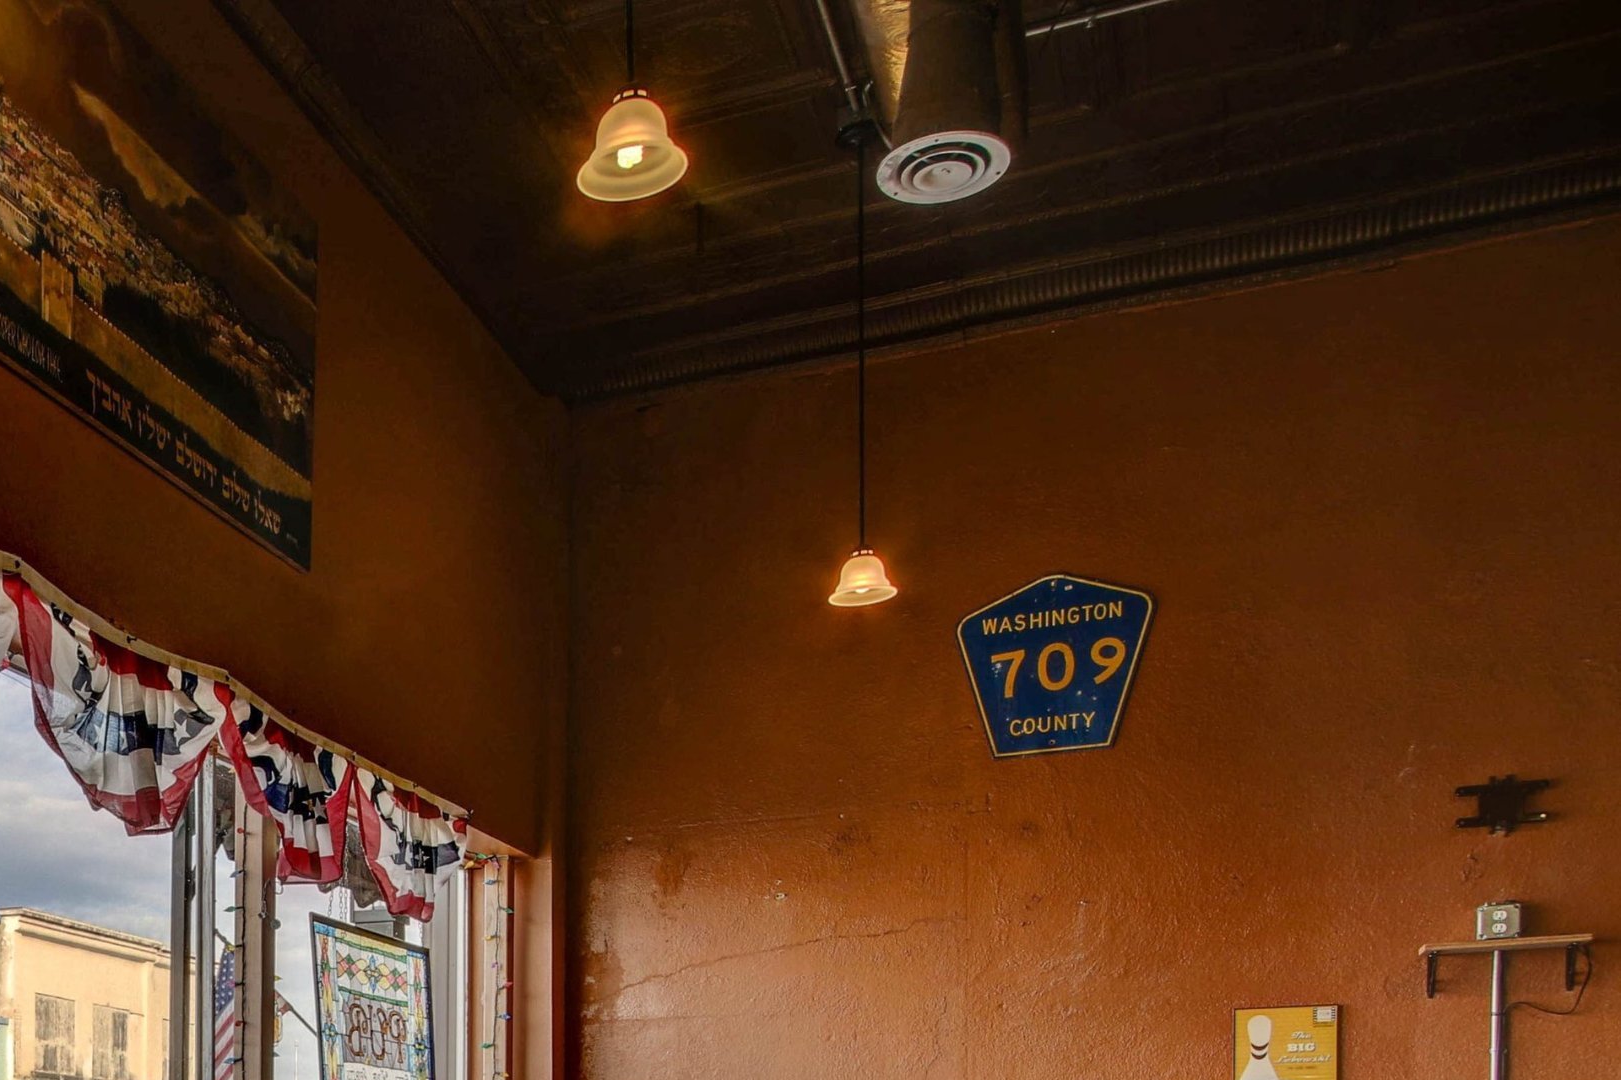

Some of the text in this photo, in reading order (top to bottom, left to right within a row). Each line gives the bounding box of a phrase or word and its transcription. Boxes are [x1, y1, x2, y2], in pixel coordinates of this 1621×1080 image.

[222, 470, 250, 512] שלום
[982, 601, 1124, 635] WASHINGTON
[991, 637, 1126, 698] 709
[1010, 711, 1096, 736] COUNTY
[1287, 1042, 1315, 1052] BIG
